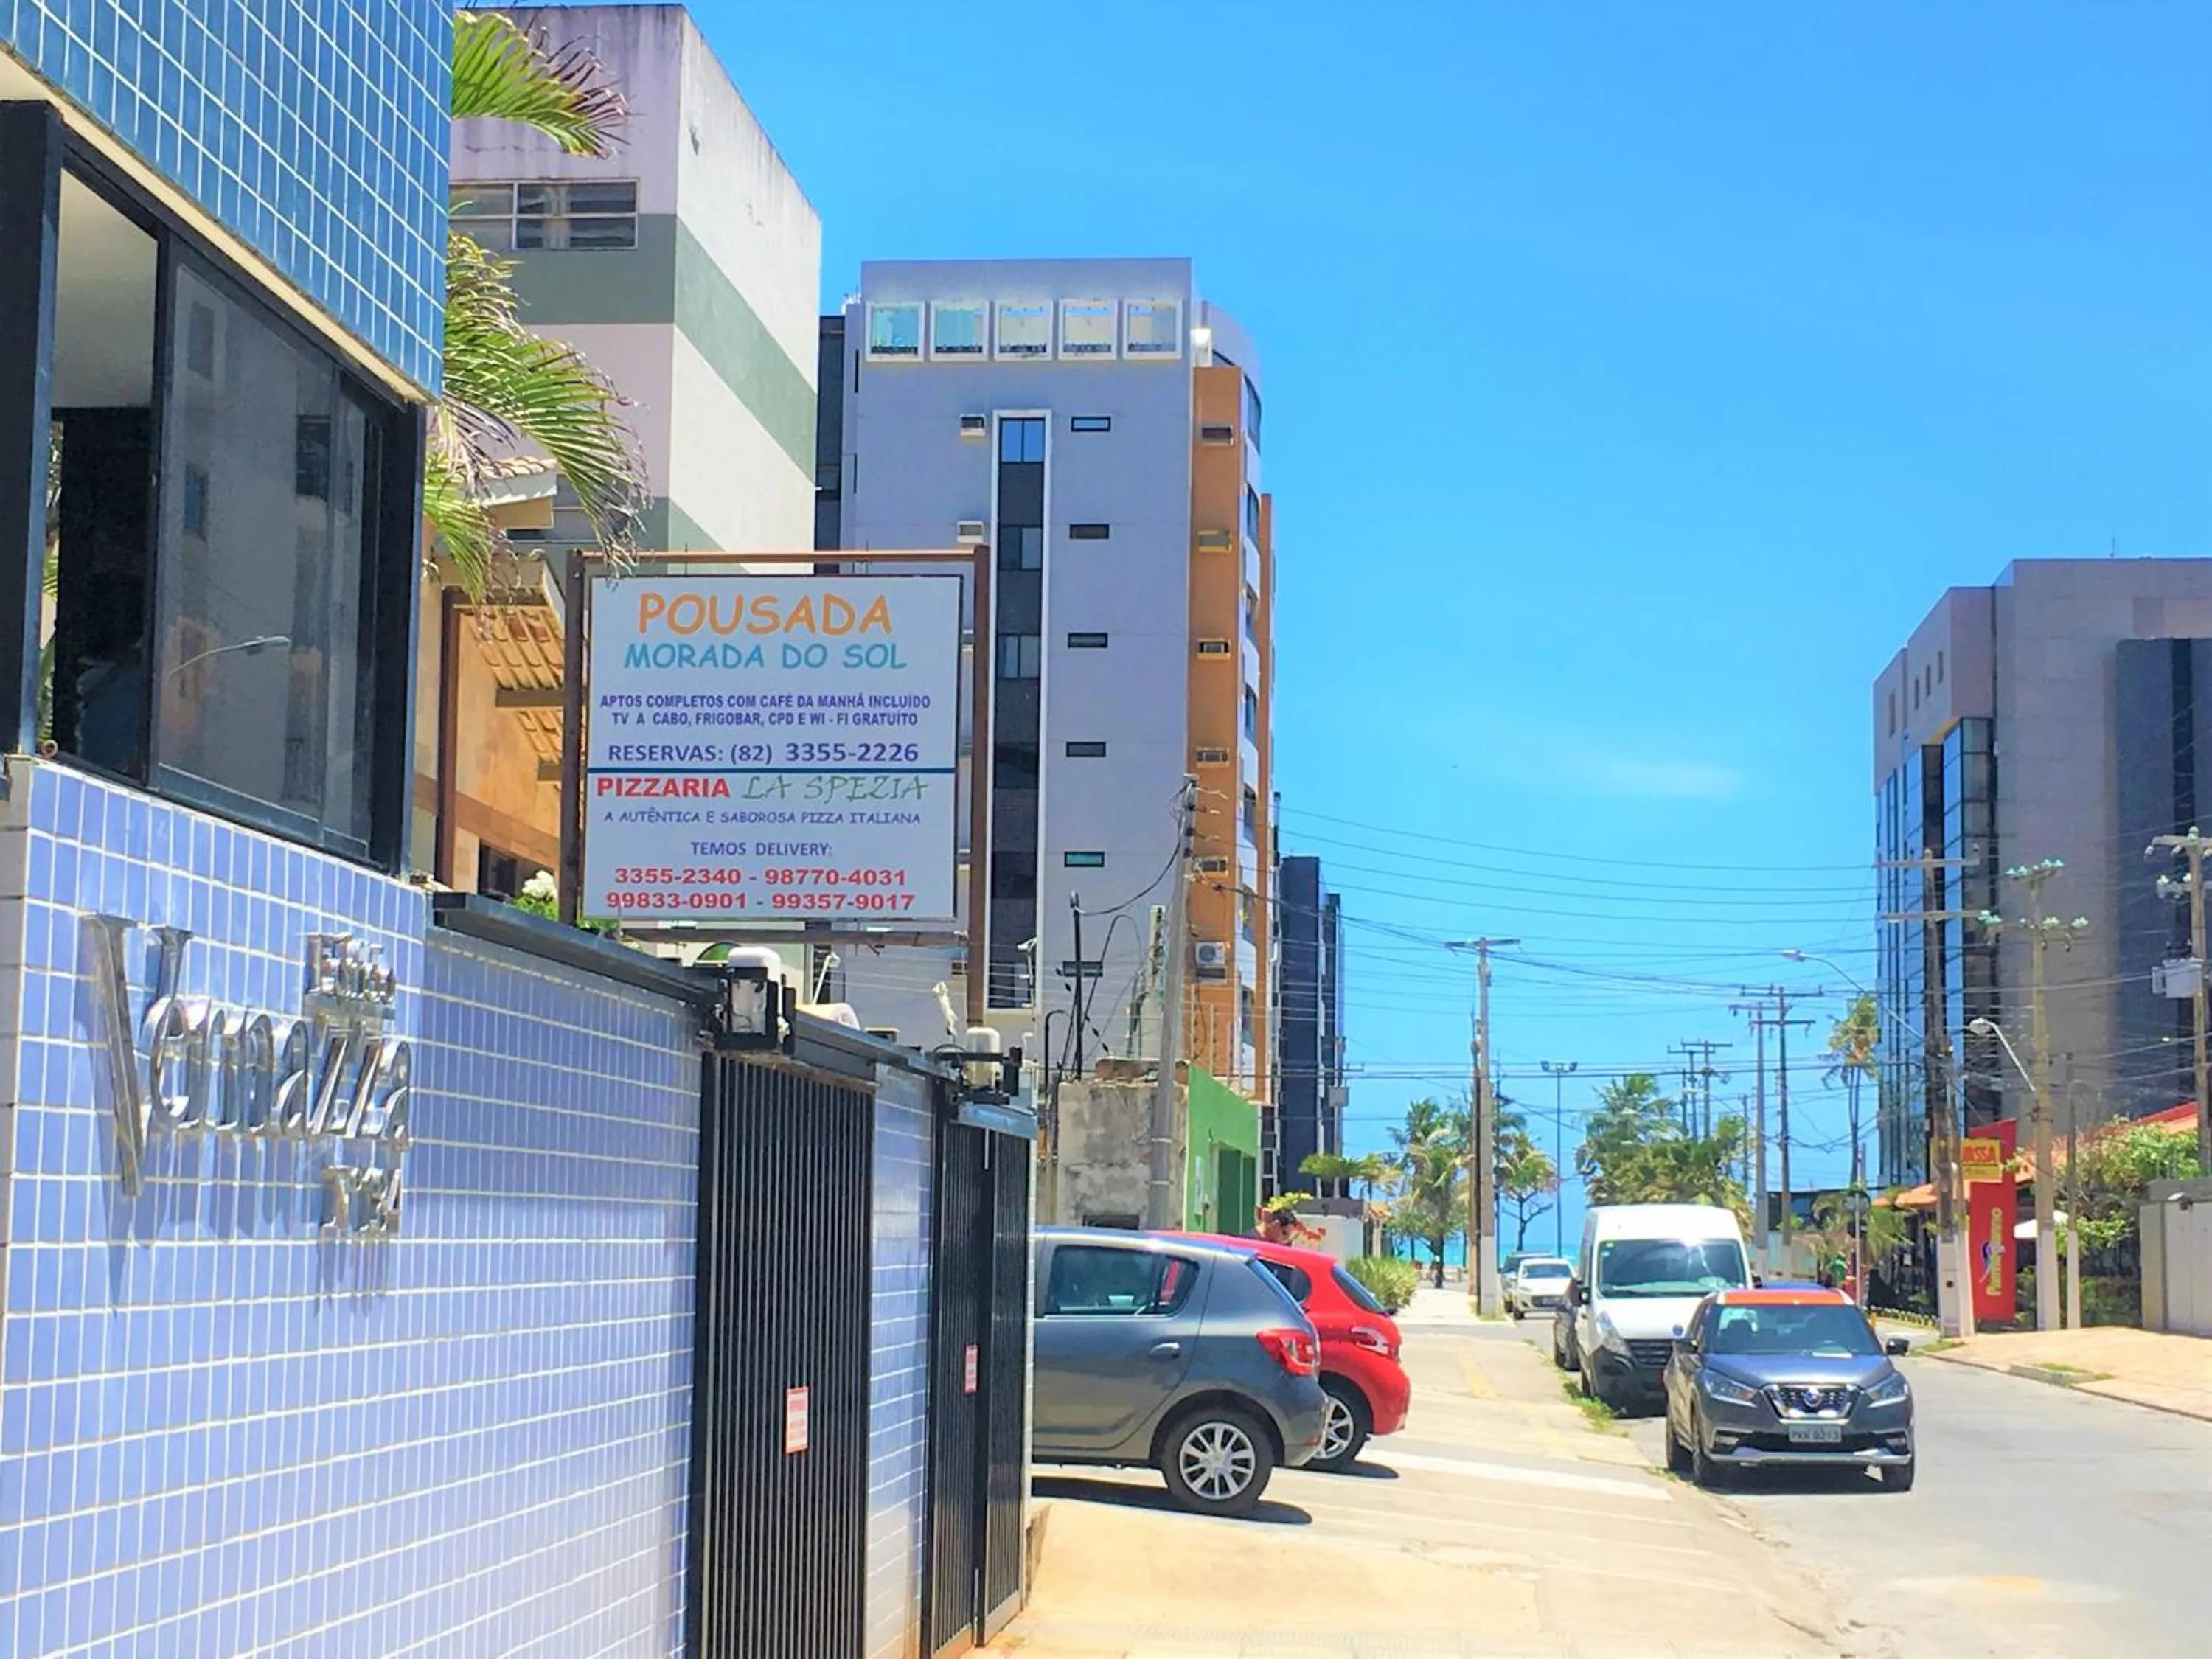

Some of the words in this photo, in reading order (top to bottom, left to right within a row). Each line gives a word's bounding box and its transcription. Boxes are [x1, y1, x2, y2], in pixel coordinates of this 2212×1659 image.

[639, 592, 892, 636] POUSADA
[625, 643, 764, 669] MORADA
[782, 643, 827, 669] DO
[842, 643, 907, 669] SOL
[600, 695, 642, 708] APTOS
[646, 695, 723, 708] COMPLETOS
[727, 695, 756, 708] COM
[760, 692, 793, 708] CAFÉ
[797, 695, 813, 708] DA
[612, 712, 629, 725] TV
[636, 712, 645, 725] A
[653, 712, 691, 726] CABO,
[696, 712, 764, 726] FRIGOBAR,
[768, 712, 794, 725] CPD
[798, 713, 806, 725] E
[609, 745, 723, 761] RESERVAS:
[731, 745, 772, 765] (82)
[787, 743, 918, 762] 3355-2226
[597, 778, 730, 798] PIZZARIA
[742, 776, 792, 799] LA
[804, 776, 928, 804] SPEZIA
[604, 812, 613, 821] A
[619, 807, 700, 823] AUTÊNTICA
[706, 811, 714, 824] E
[720, 812, 796, 823] SABOROSA
[801, 812, 844, 824] PIZZA
[850, 813, 920, 824] ITALIANA
[691, 842, 746, 855] TEMOS
[756, 842, 832, 856] DELIVERY:
[615, 868, 741, 884] 3355-2340
[765, 869, 904, 885] 98770-4031
[607, 892, 745, 908] 99833-0901
[772, 893, 914, 910] 99357-9017
